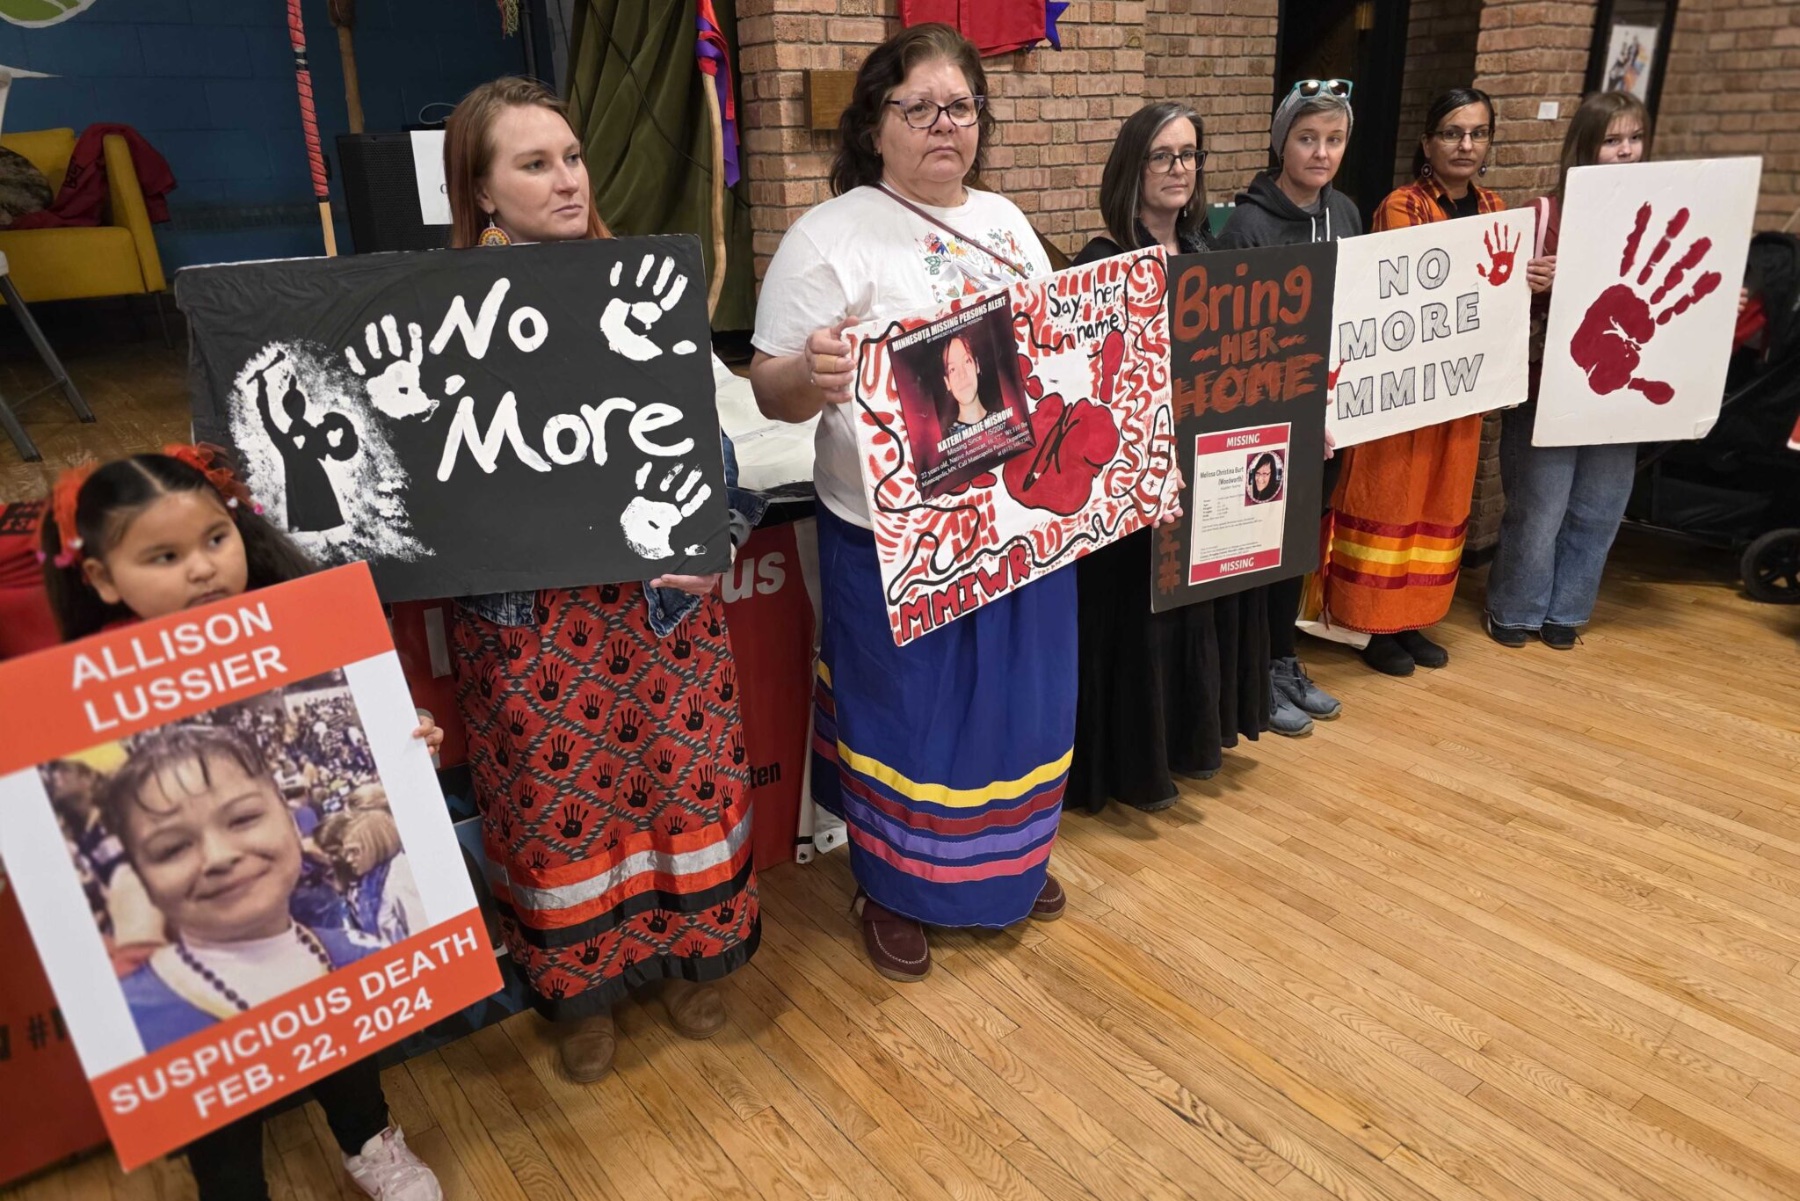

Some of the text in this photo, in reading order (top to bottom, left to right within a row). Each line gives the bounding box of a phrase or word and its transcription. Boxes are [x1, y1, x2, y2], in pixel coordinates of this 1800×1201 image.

[1048, 277, 1121, 319] Say her
[1174, 264, 1312, 342] Bring
[1378, 247, 1451, 299] NO
[429, 277, 549, 360] No
[892, 296, 1007, 352] MINNESOTA MISSING PERSONS ALERT
[1077, 312, 1119, 342] name
[1220, 327, 1277, 365] HER
[1338, 292, 1480, 362] MORE
[1174, 354, 1322, 425] HOME
[1336, 353, 1485, 421] MMIW
[437, 390, 695, 482] More
[937, 434, 961, 453] KATERI
[961, 421, 985, 441] MARIE
[947, 442, 968, 456] Missing
[968, 435, 983, 446] Since
[1226, 433, 1261, 448] MISSING
[901, 544, 1031, 641] MMIWR
[1220, 557, 1255, 574] MISSING
[70, 602, 274, 690] ALLISON
[83, 645, 288, 732] LUSSIER
[108, 986, 352, 1116] SUSPICIOUS
[358, 926, 479, 1001] DEATH
[192, 987, 434, 1120] FEB. 22, 2024
